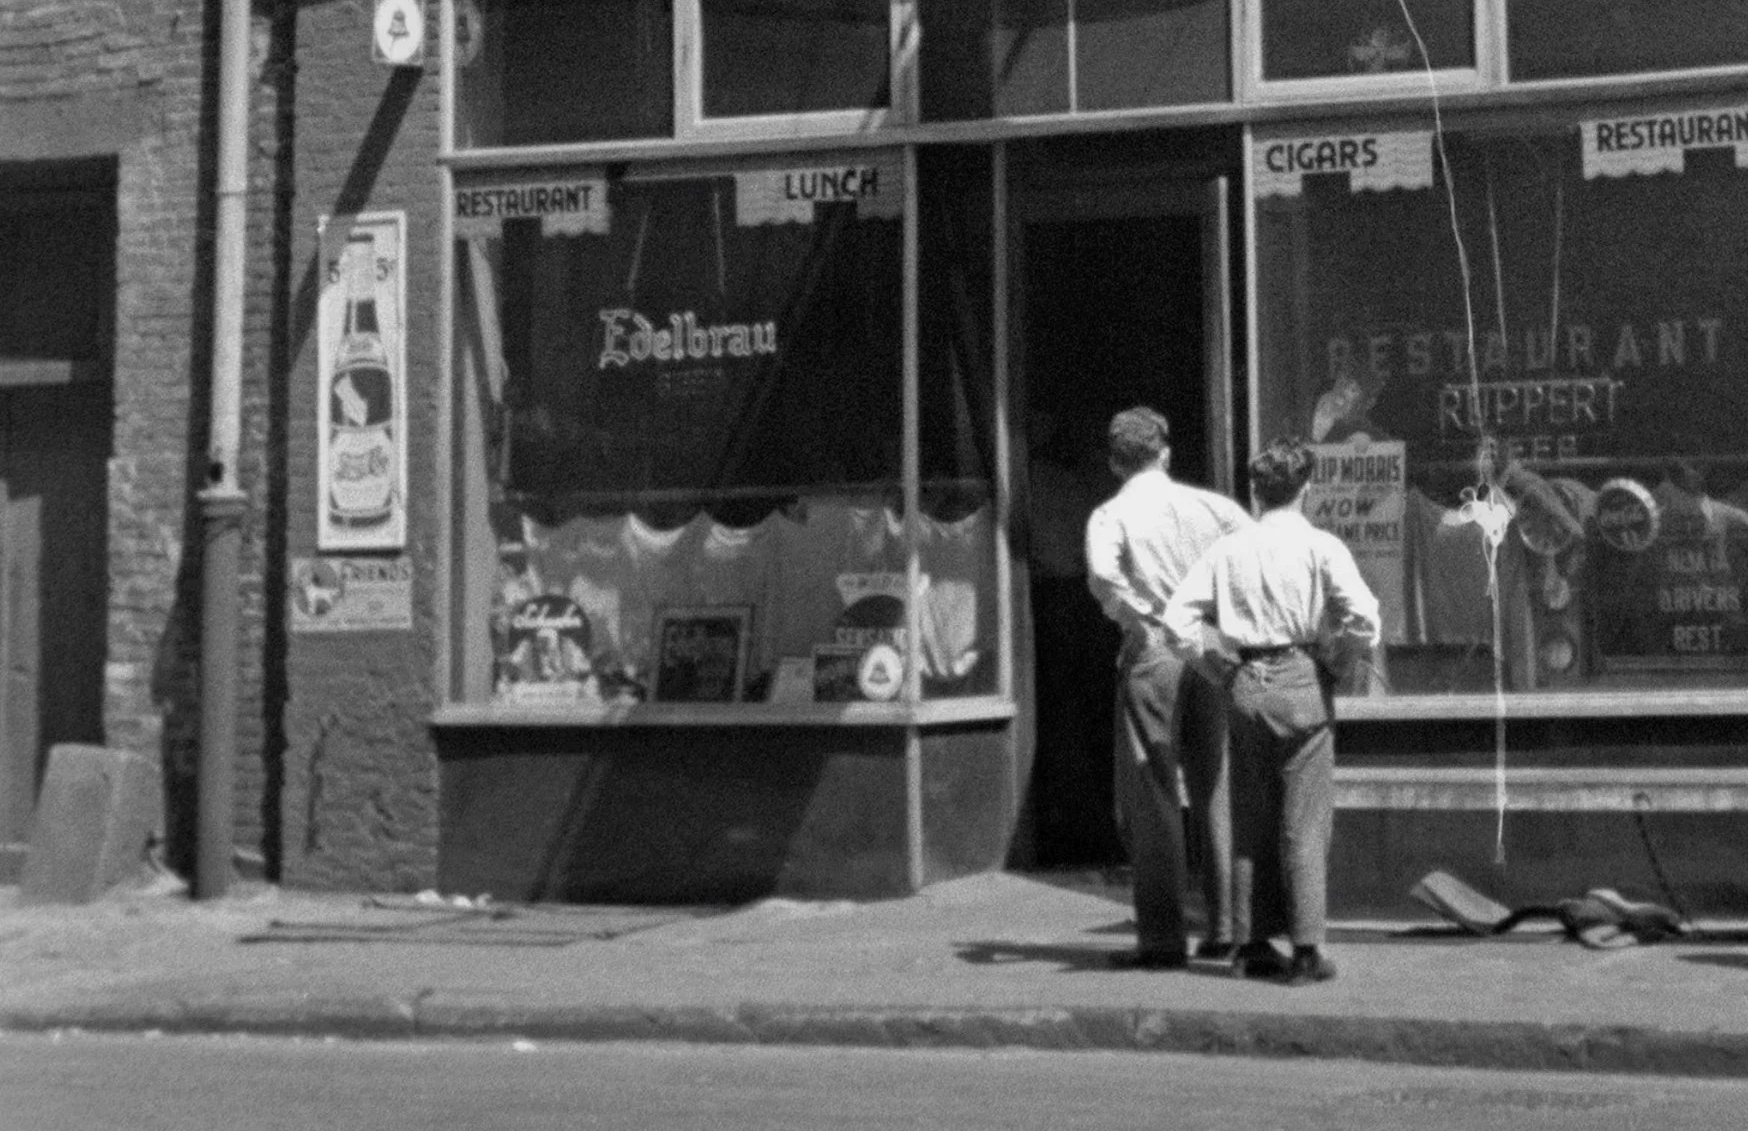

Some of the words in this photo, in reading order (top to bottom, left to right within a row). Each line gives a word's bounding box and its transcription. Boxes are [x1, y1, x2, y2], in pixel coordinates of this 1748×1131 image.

[1266, 138, 1378, 172] CIGARS
[456, 185, 592, 217] RESTAURANT
[785, 170, 879, 201] LUNCH
[599, 307, 778, 369] Edelbrau
[1327, 318, 1722, 380] RESTAURANT
[1438, 379, 1626, 430] RUPPERT
[1341, 454, 1401, 483] MORRIS
[1316, 498, 1375, 518] NOW
